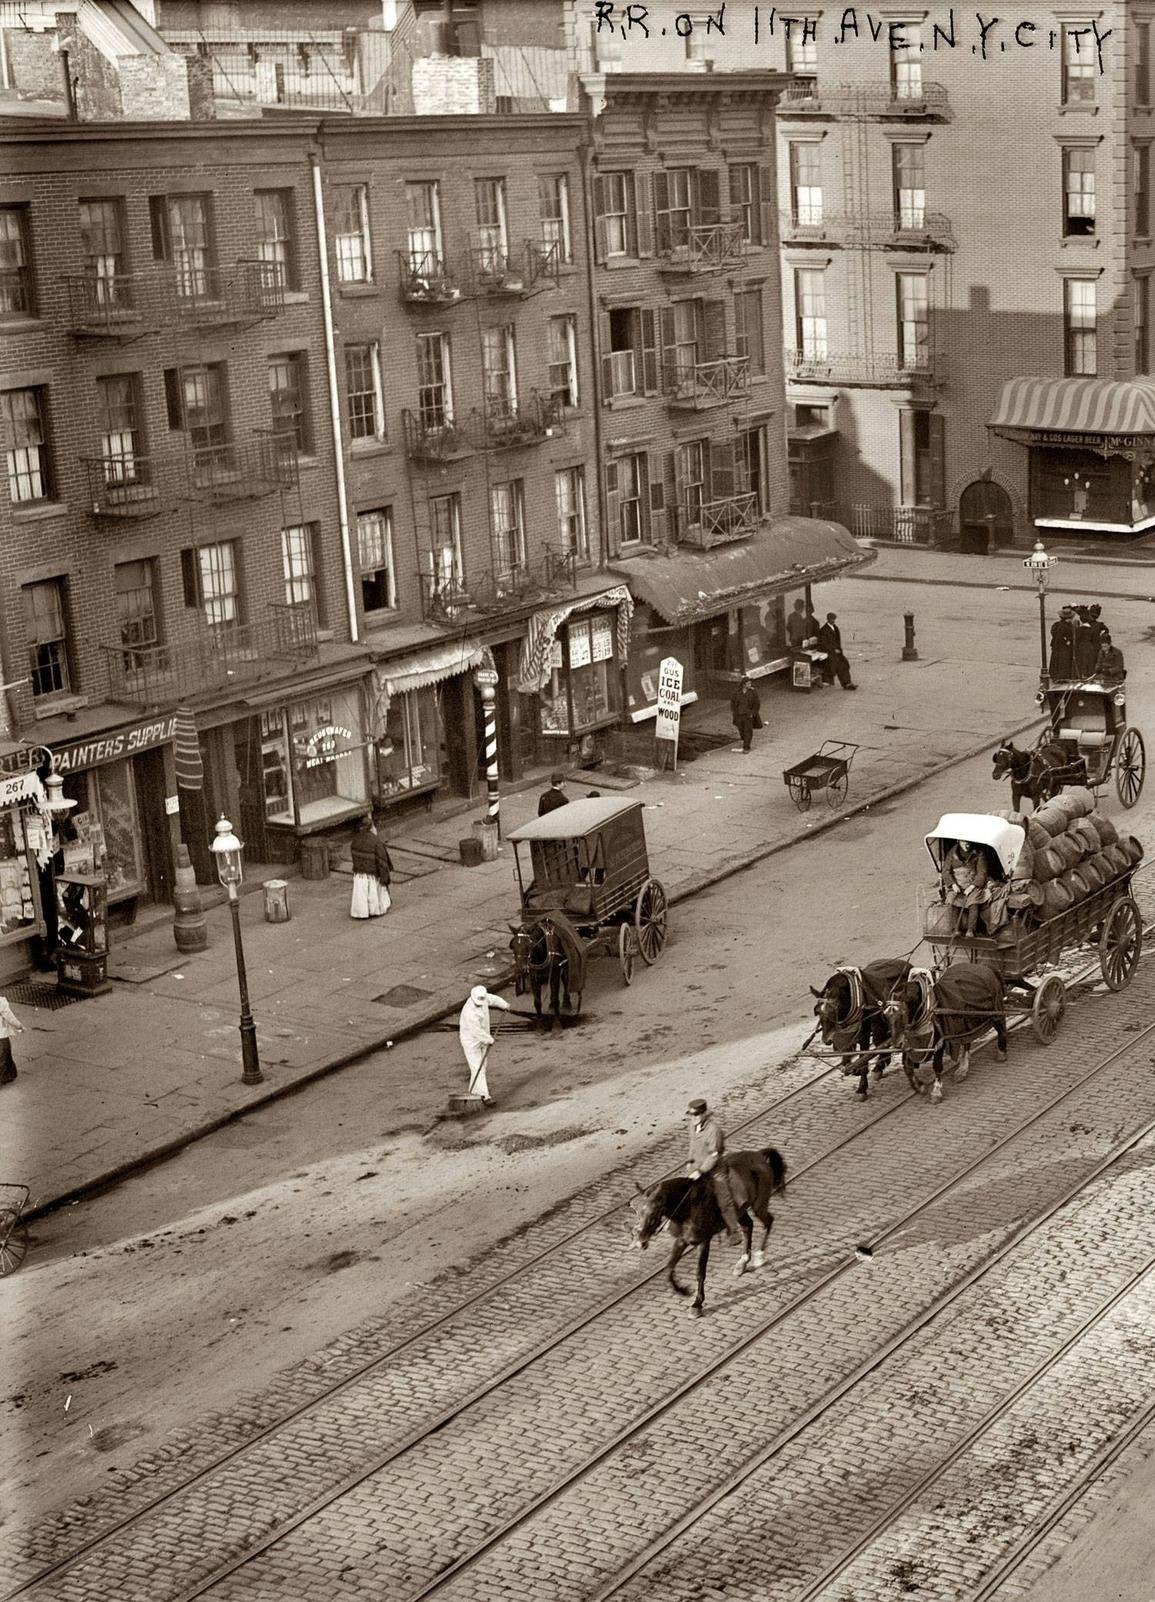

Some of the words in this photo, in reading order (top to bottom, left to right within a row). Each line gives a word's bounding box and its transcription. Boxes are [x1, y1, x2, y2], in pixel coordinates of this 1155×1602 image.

[661, 676, 680, 690] ICE
[659, 688, 680, 702] COAL
[657, 707, 679, 721] WOOD
[53, 736, 125, 772] PAINTERS
[128, 717, 178, 750] SUPPLIE
[306, 757, 323, 769] MEAT
[6, 779, 24, 794] 267
